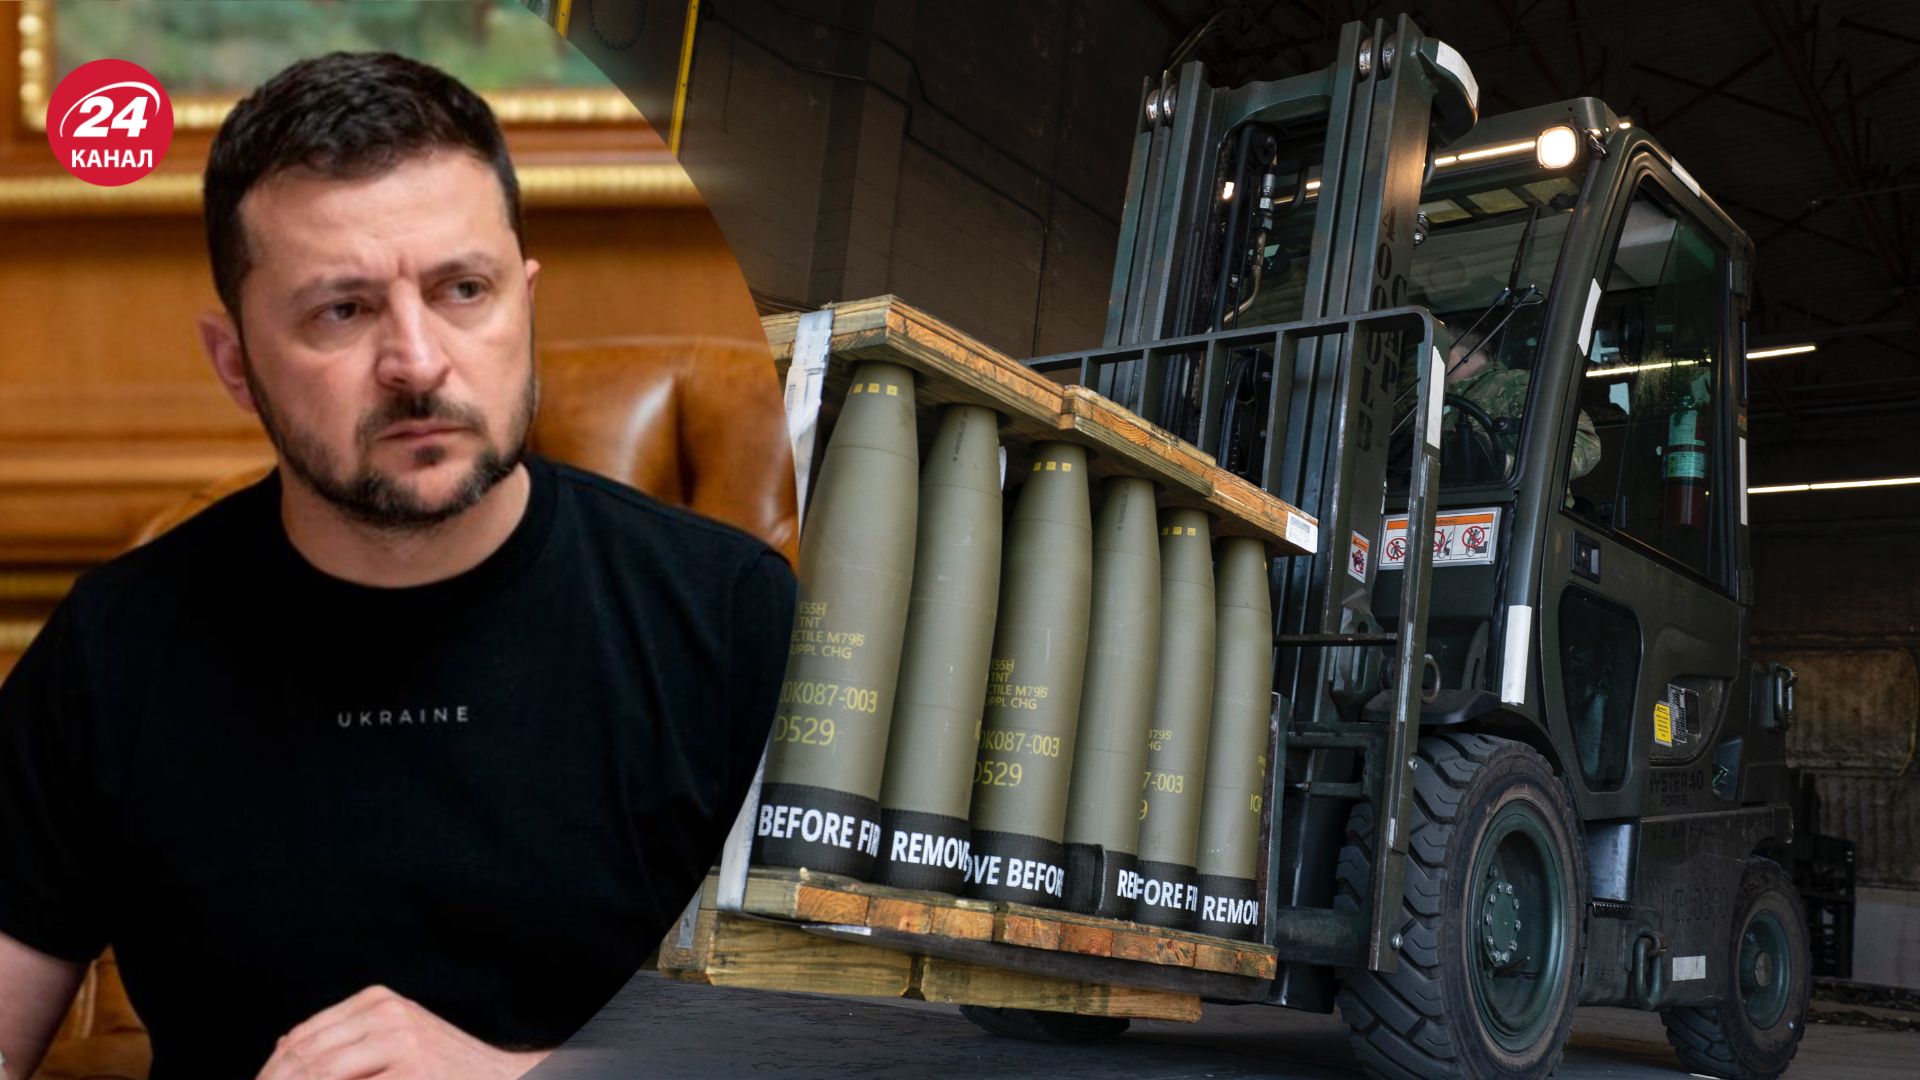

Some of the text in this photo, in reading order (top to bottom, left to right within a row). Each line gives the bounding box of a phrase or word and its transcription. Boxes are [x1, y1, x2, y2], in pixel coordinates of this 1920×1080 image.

[799, 617, 822, 628] TNT
[821, 645, 853, 660] CHG
[1010, 697, 1038, 710] CHG
[337, 706, 469, 728] UKRAINE
[758, 804, 855, 849] BEFORE
